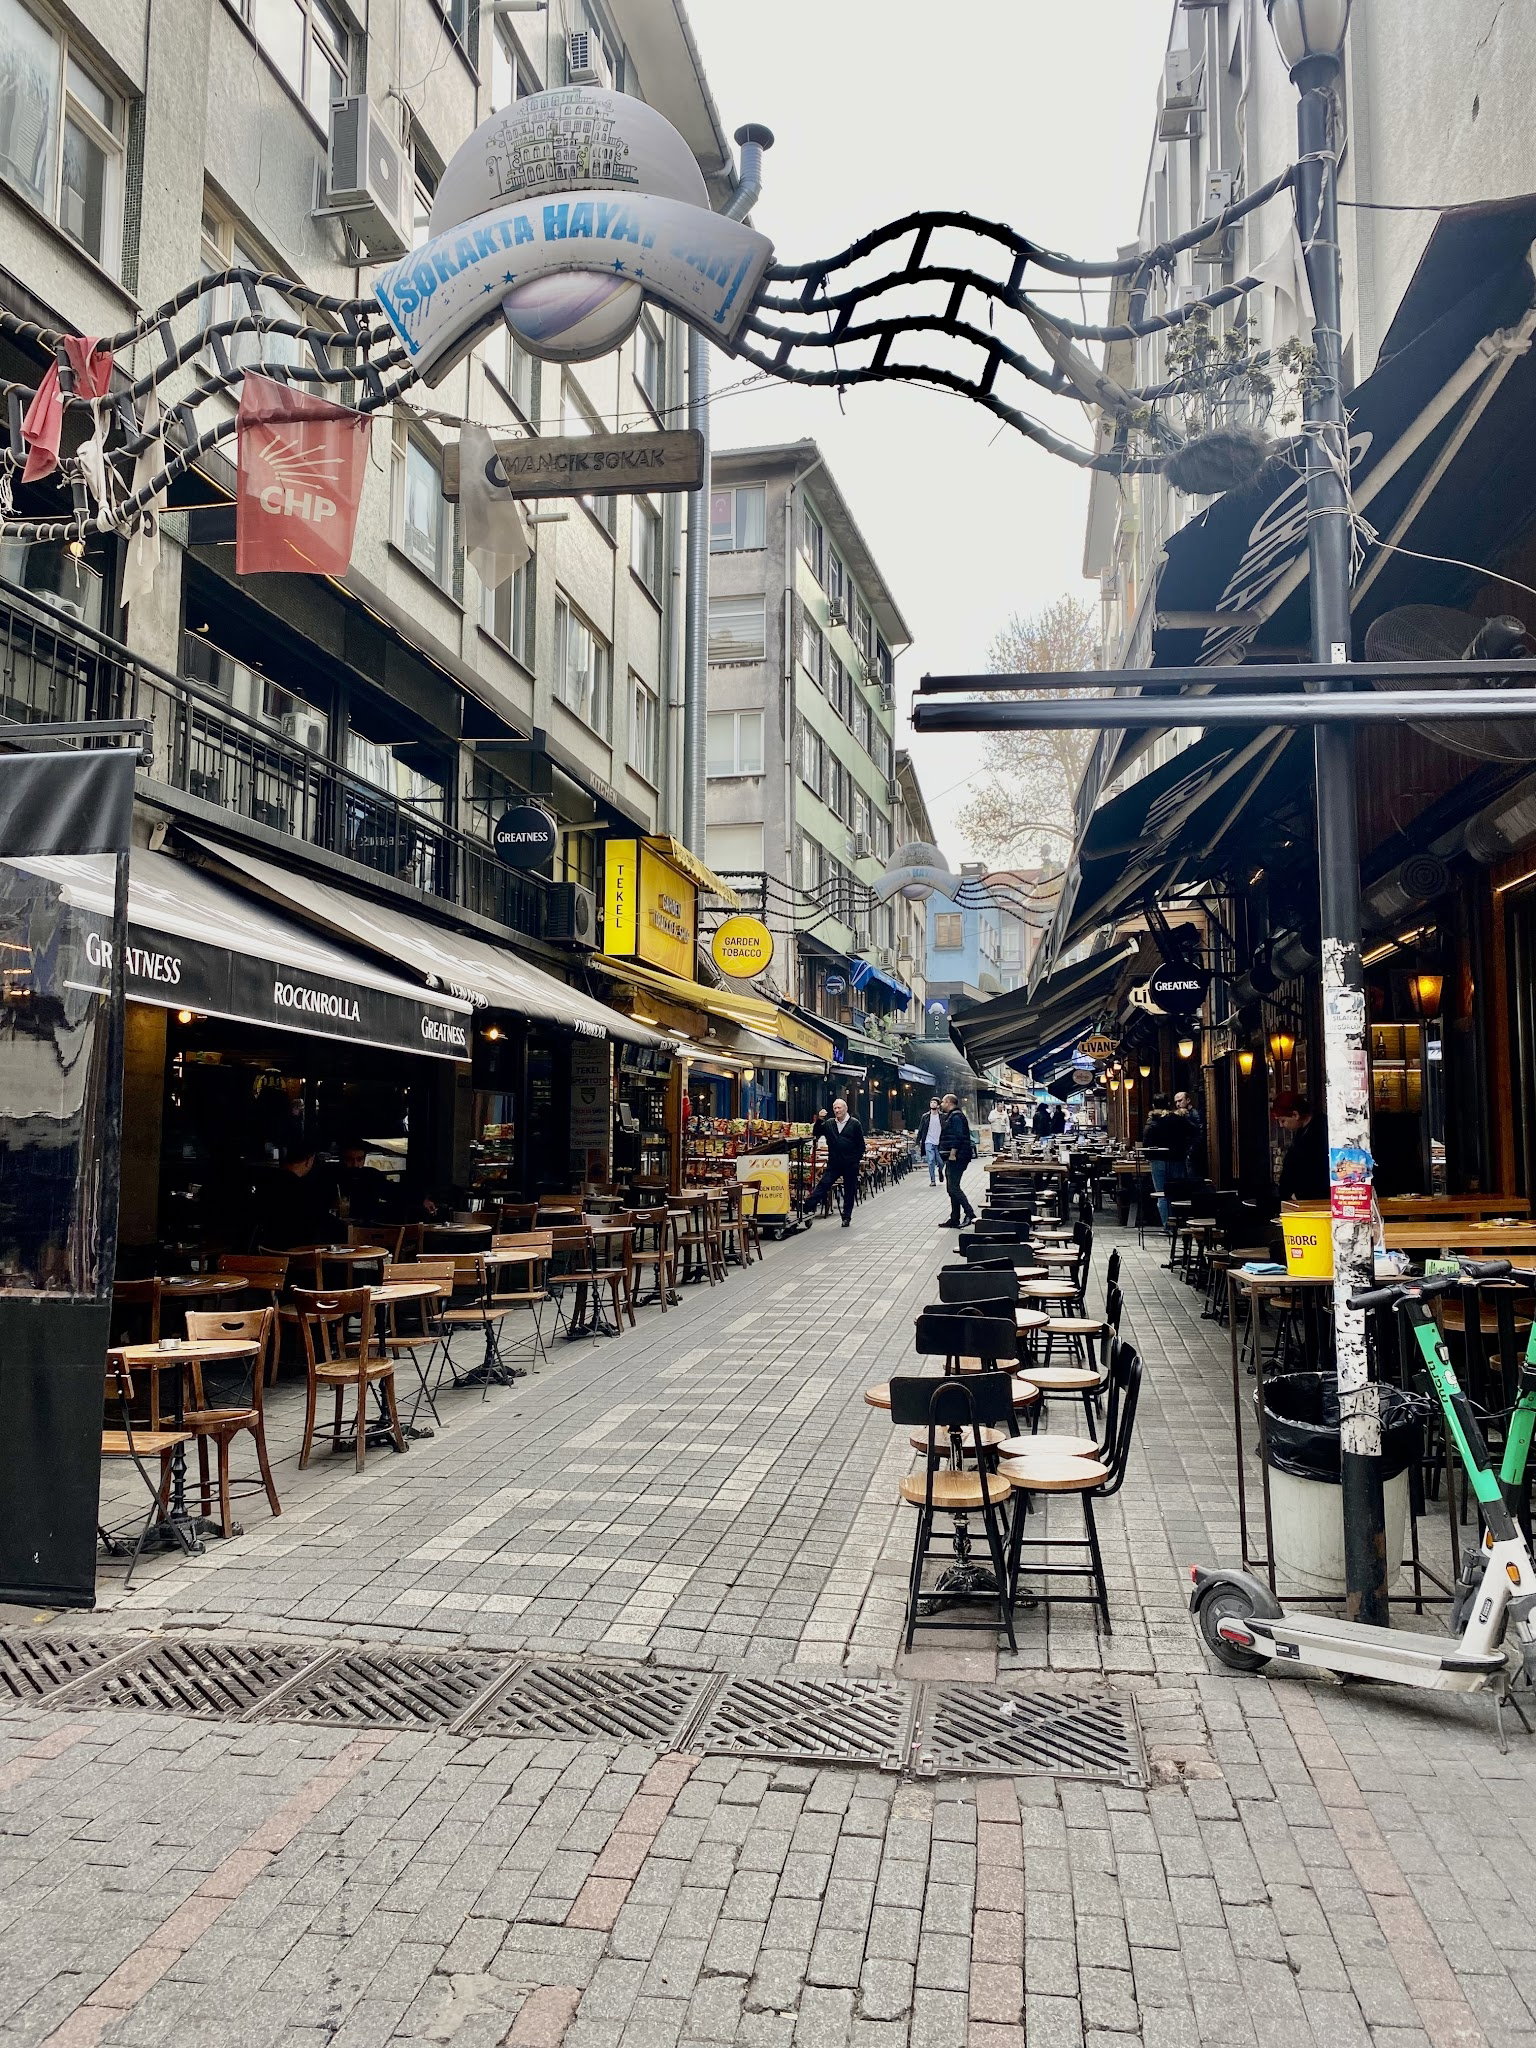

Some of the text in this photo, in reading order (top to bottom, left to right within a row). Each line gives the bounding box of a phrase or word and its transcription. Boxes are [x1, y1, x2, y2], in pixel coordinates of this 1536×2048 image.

[393, 215, 535, 314] SOKAKTA
[593, 449, 665, 471] SOKAK
[260, 486, 337, 522] CHP
[497, 831, 548, 843] GREATNESS
[616, 865, 624, 928] TEKEL
[722, 947, 762, 957] TOBACCO
[724, 937, 760, 946] GARDEN
[86, 932, 181, 984] GRATNESS
[1155, 980, 1200, 991] GREATNES
[274, 981, 360, 1022] ROCKNROLLA
[421, 1016, 466, 1046] GREATNESS
